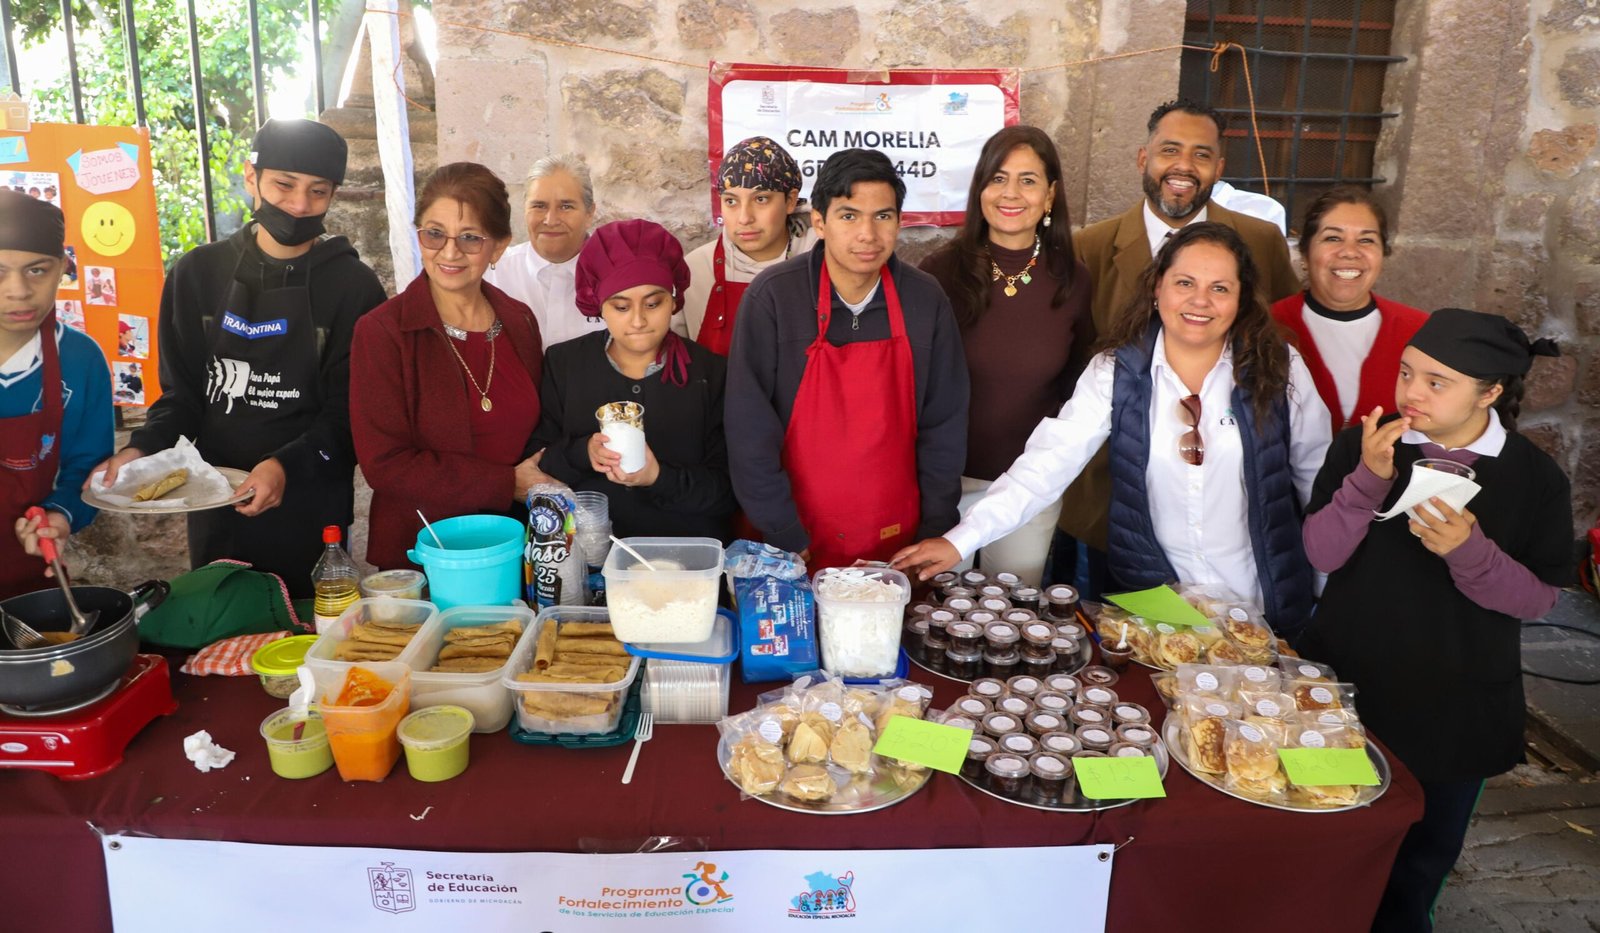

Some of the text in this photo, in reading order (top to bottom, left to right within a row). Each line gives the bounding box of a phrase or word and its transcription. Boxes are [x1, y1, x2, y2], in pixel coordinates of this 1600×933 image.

[786, 129, 941, 149] CAM MORELIA
[82, 152, 122, 168] SOMOS
[224, 315, 282, 335] TRAMONTINA
[537, 566, 556, 584] 25
[426, 870, 494, 882] Secretaría
[427, 882, 518, 893] de Educación
[601, 887, 682, 899] Programa
[558, 895, 683, 909] Fortalecimiento
